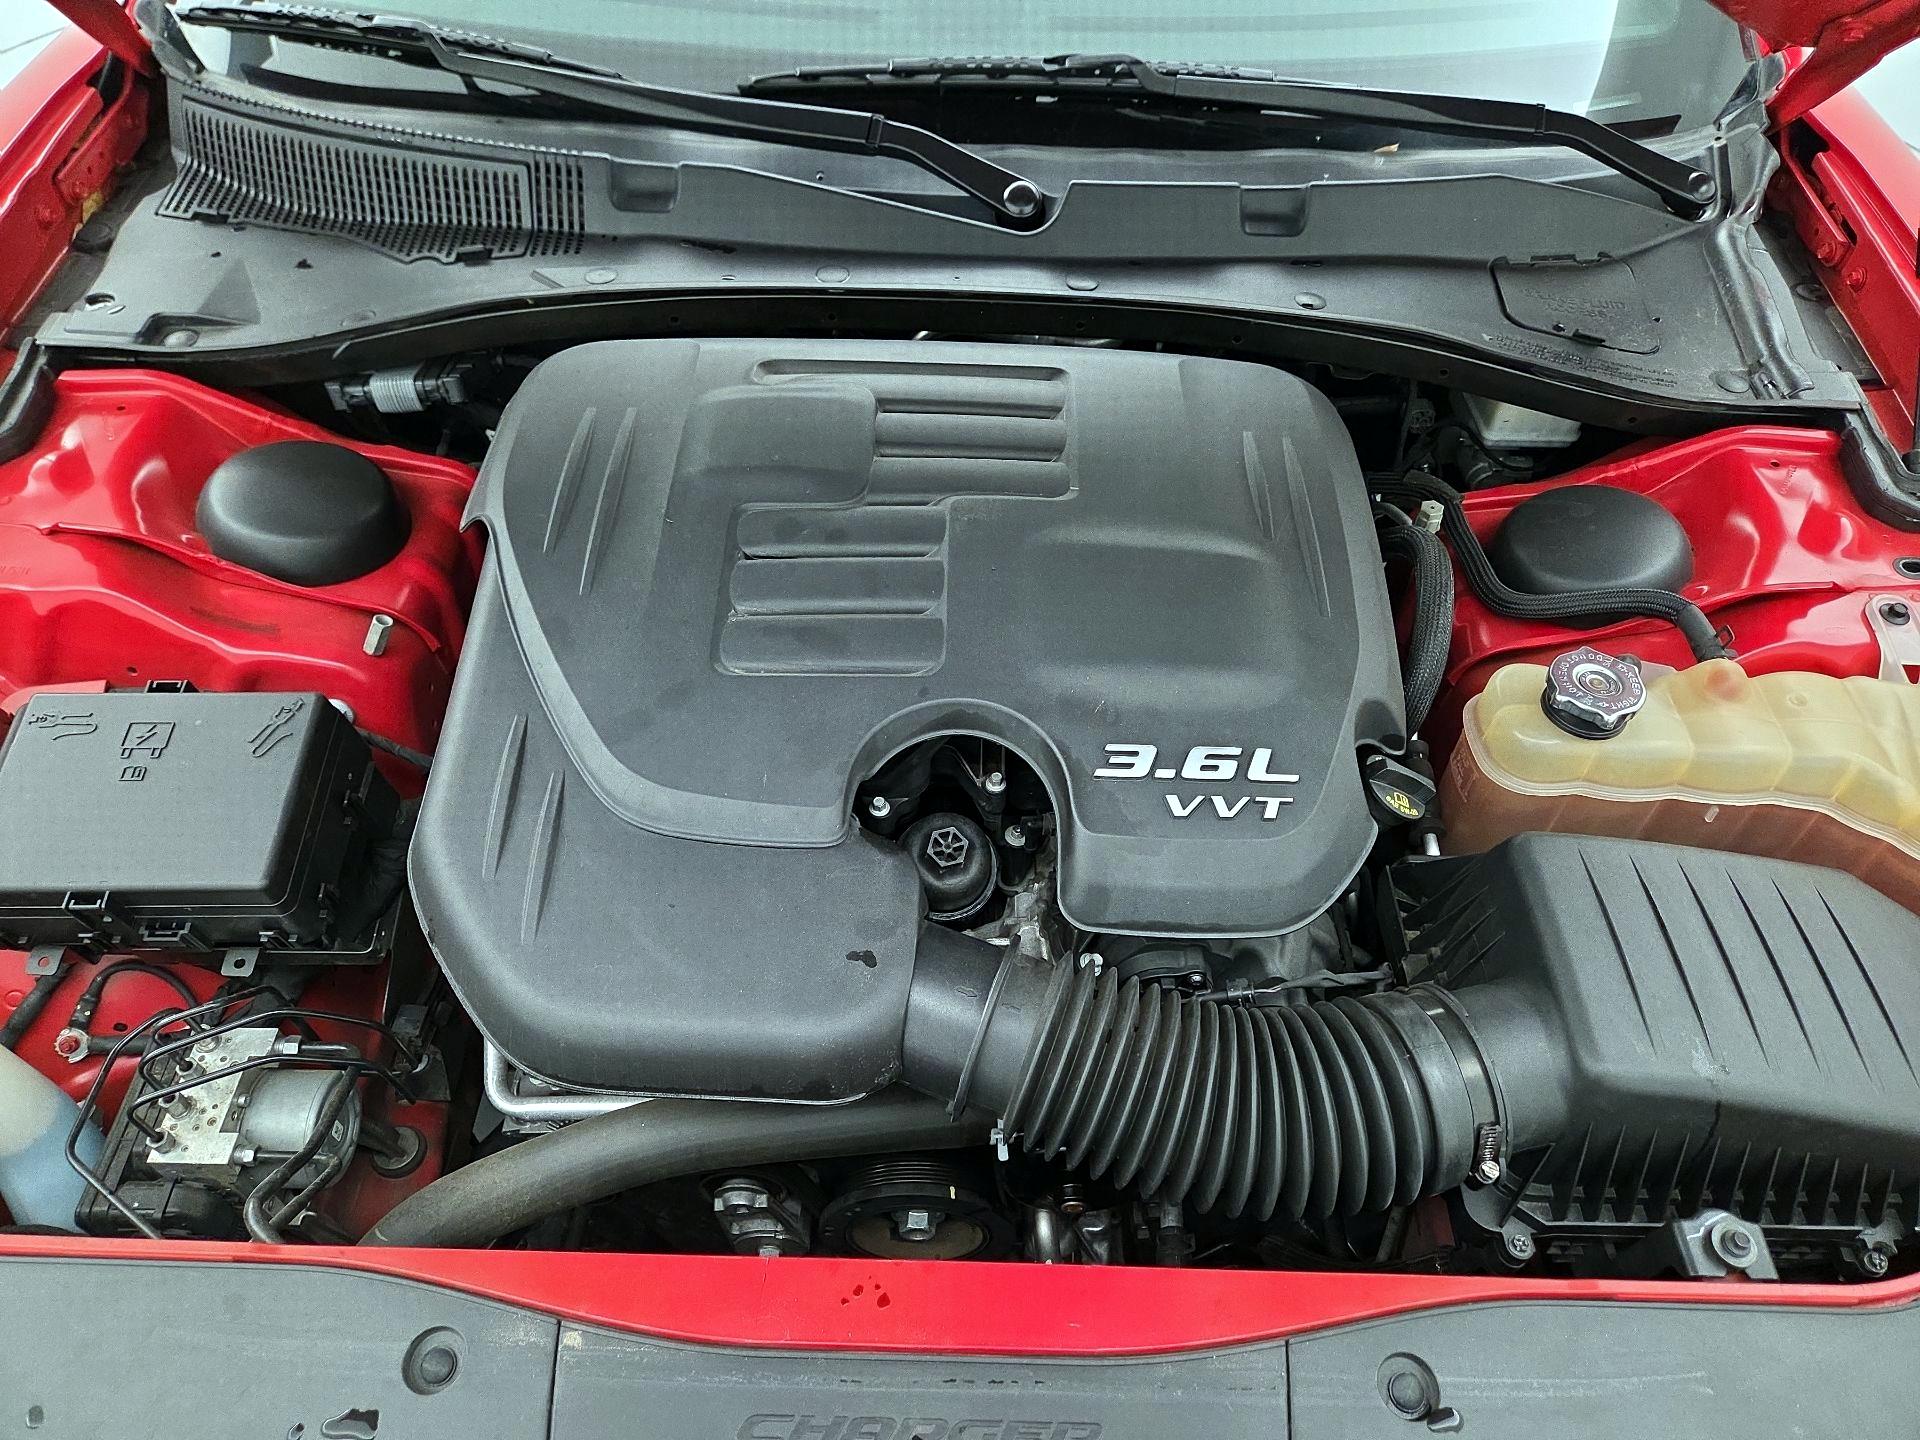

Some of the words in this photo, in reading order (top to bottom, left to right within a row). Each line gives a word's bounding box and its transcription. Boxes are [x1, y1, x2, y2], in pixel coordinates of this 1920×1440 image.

[1567, 653, 1587, 665] NOT
[1588, 652, 1603, 662] DO
[1562, 682, 1584, 698] HOT
[1625, 672, 1641, 695] KEEP
[1609, 696, 1638, 710] TIGHT
[1093, 743, 1300, 783] 3.6L
[1165, 794, 1294, 820] VVT
[736, 1413, 1103, 1440] CHARGER
